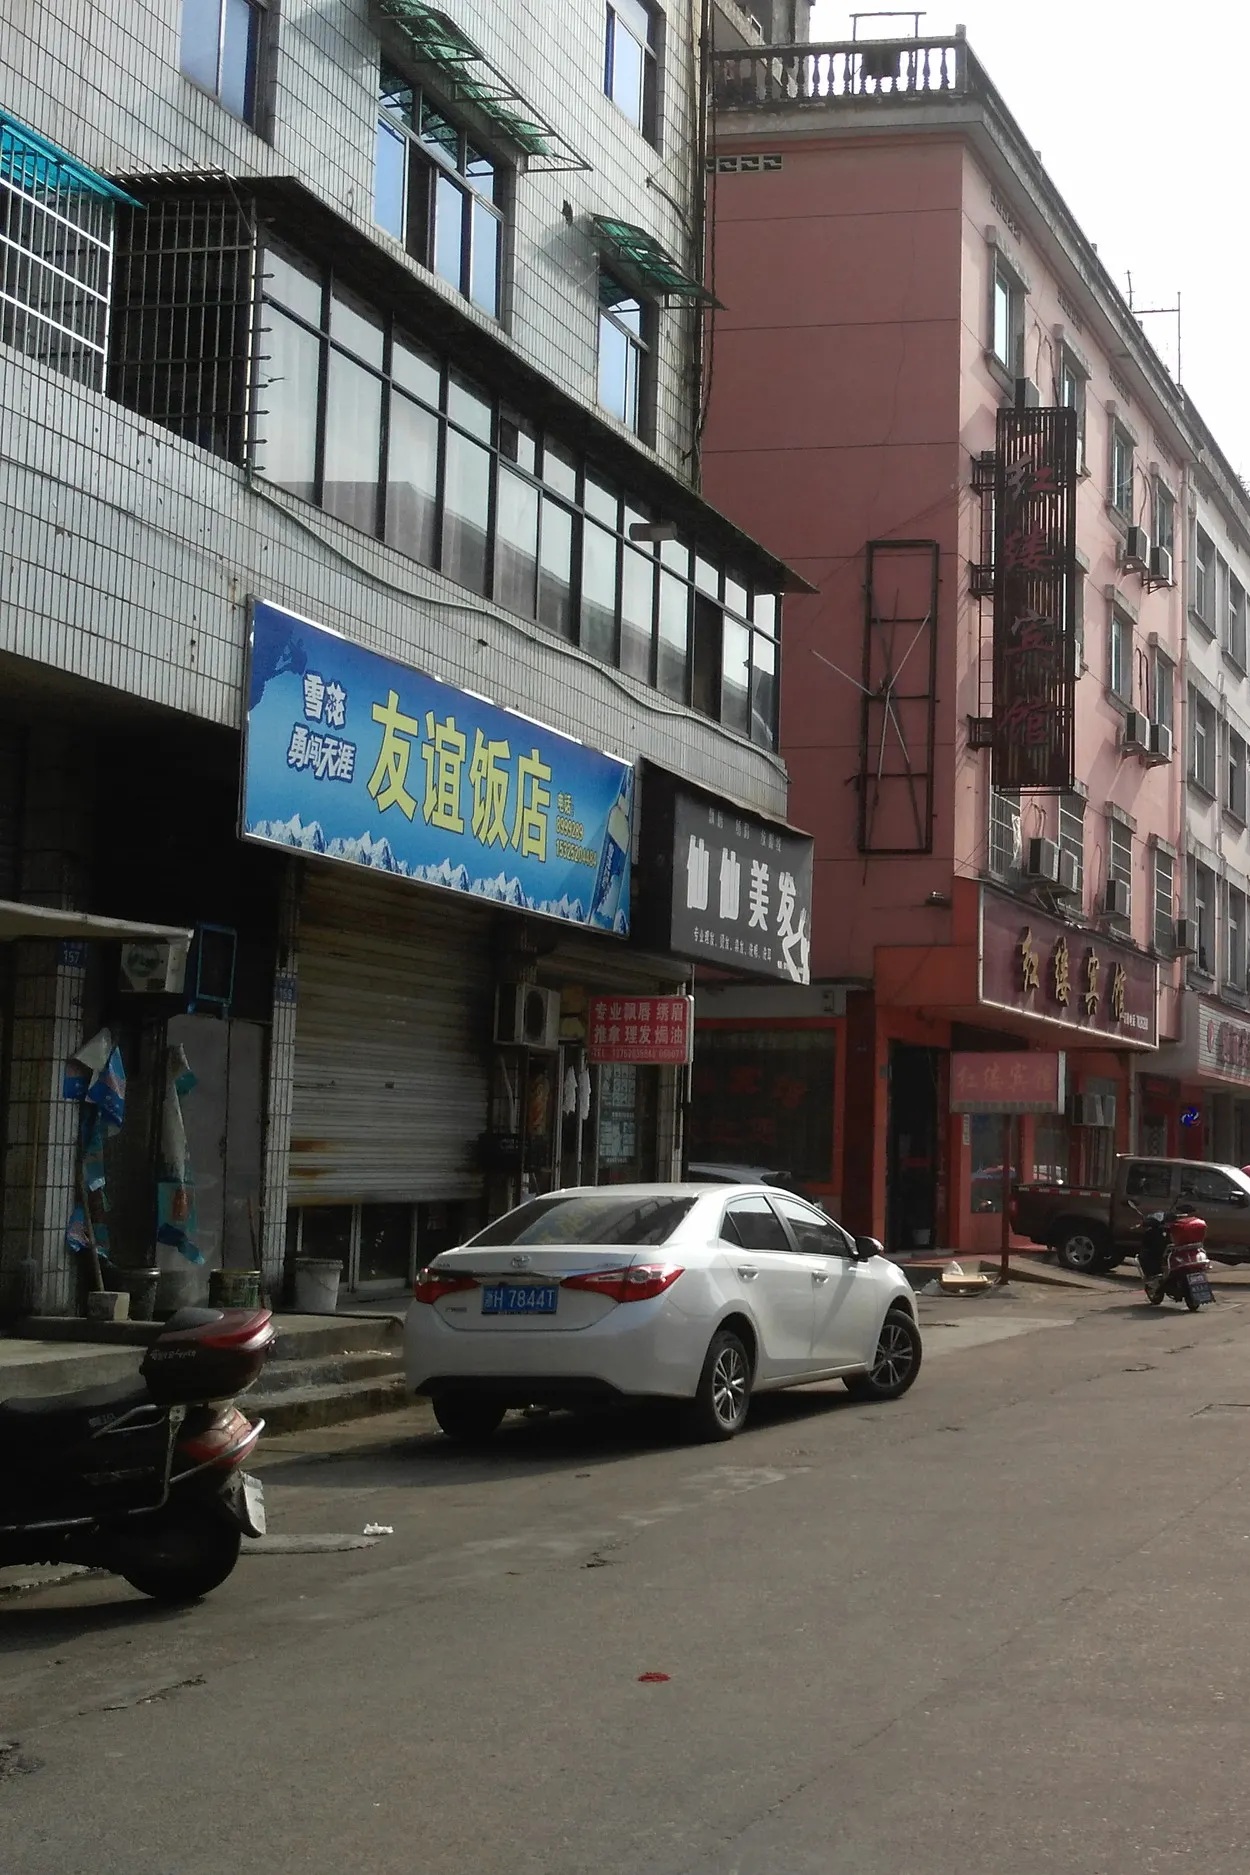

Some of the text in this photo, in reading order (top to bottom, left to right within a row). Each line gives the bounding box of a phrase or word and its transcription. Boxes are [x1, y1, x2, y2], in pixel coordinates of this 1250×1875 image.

[304, 670, 347, 729] 雪花
[288, 722, 356, 782] 勇闯天涯
[367, 689, 552, 863] 友谊饭店
[625, 1024, 651, 1044] 理发
